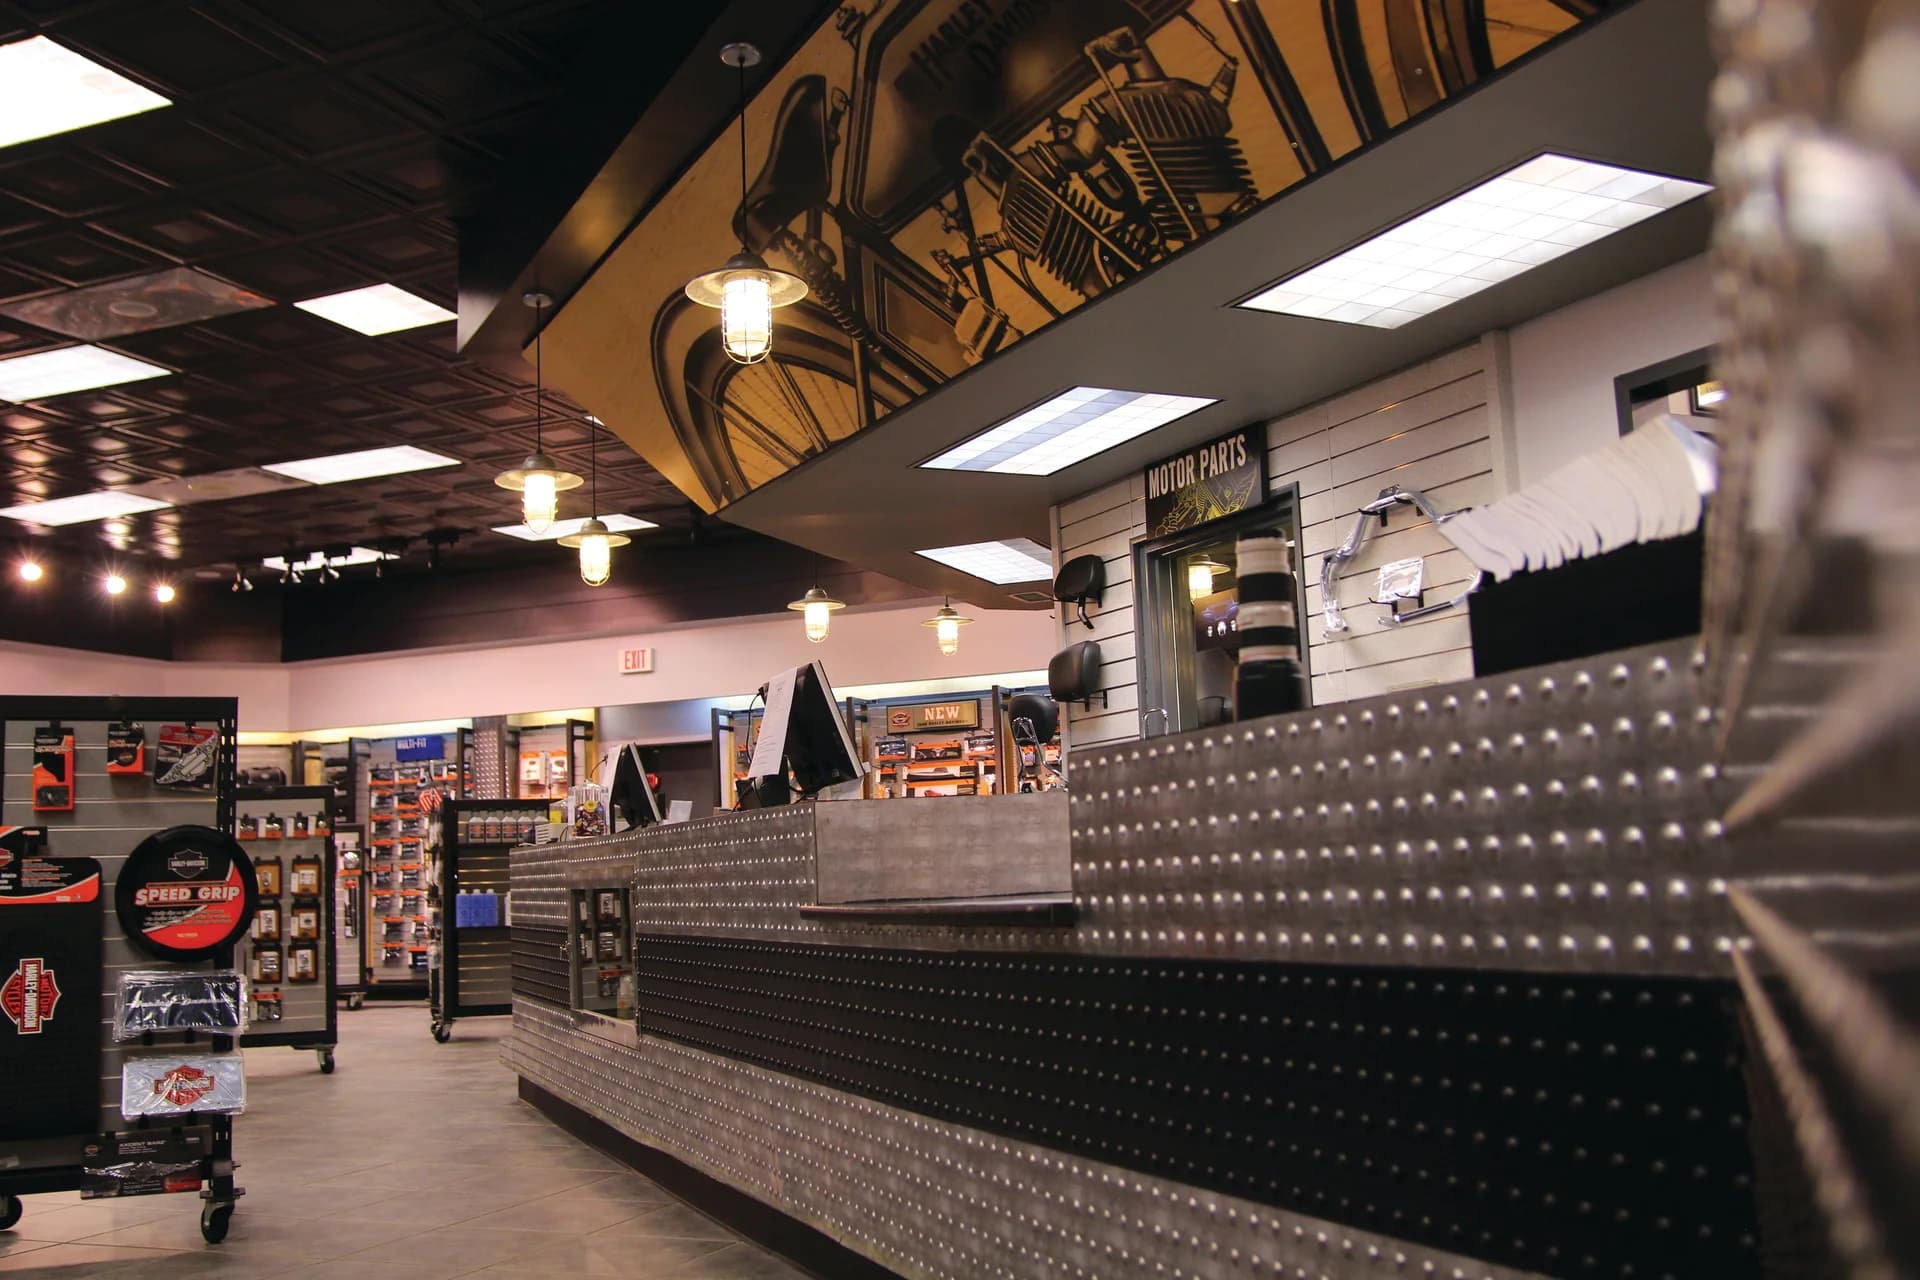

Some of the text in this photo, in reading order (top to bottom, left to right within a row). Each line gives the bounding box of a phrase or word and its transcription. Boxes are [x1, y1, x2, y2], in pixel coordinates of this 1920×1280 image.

[1148, 433, 1247, 499] MOTOR PARTS
[624, 649, 647, 670] EXIT
[924, 705, 960, 721] NEW
[134, 885, 241, 906] SPEED GRIP
[24, 963, 39, 1029] HARLEY-DAVIDSON
